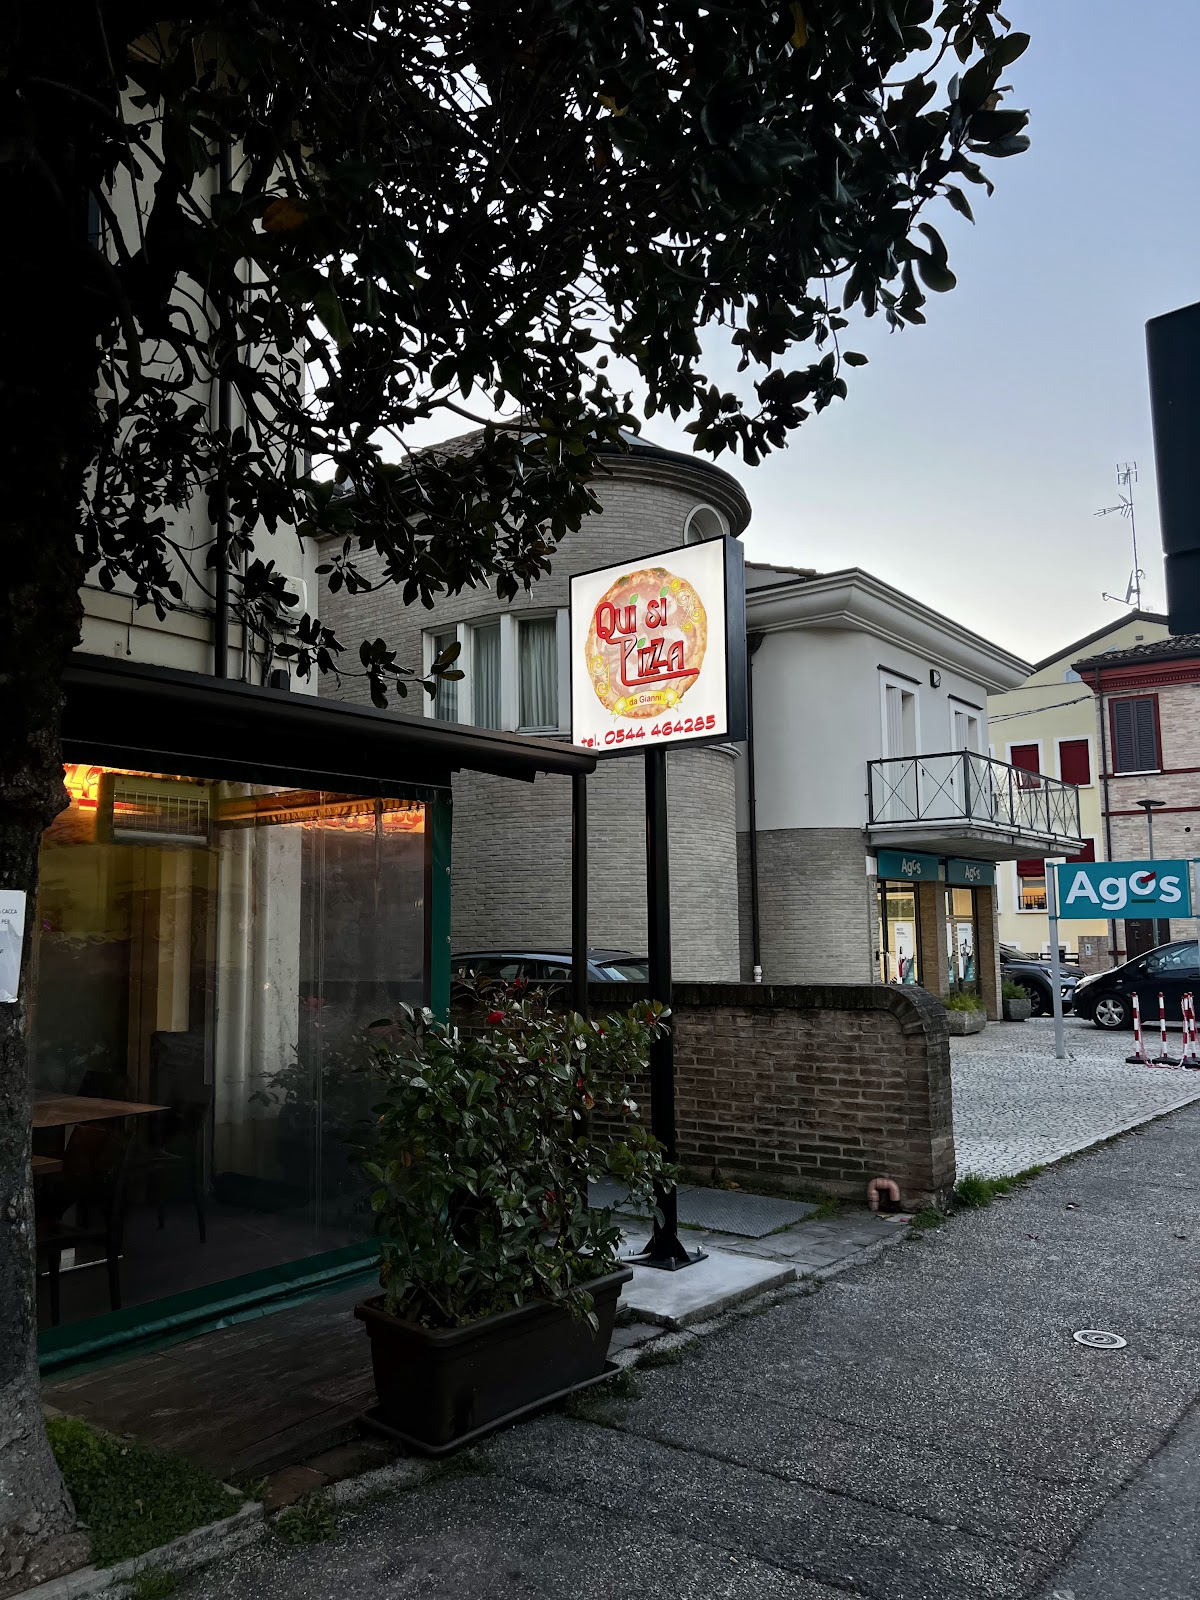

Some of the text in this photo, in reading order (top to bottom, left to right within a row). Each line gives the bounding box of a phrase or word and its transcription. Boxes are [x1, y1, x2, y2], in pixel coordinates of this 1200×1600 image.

[629, 694, 662, 706] da Gianni
[581, 714, 716, 747] tel. 0544 464285
[901, 857, 921, 877] Agos
[964, 865, 980, 881] Agos
[1065, 870, 1181, 911] Agos
